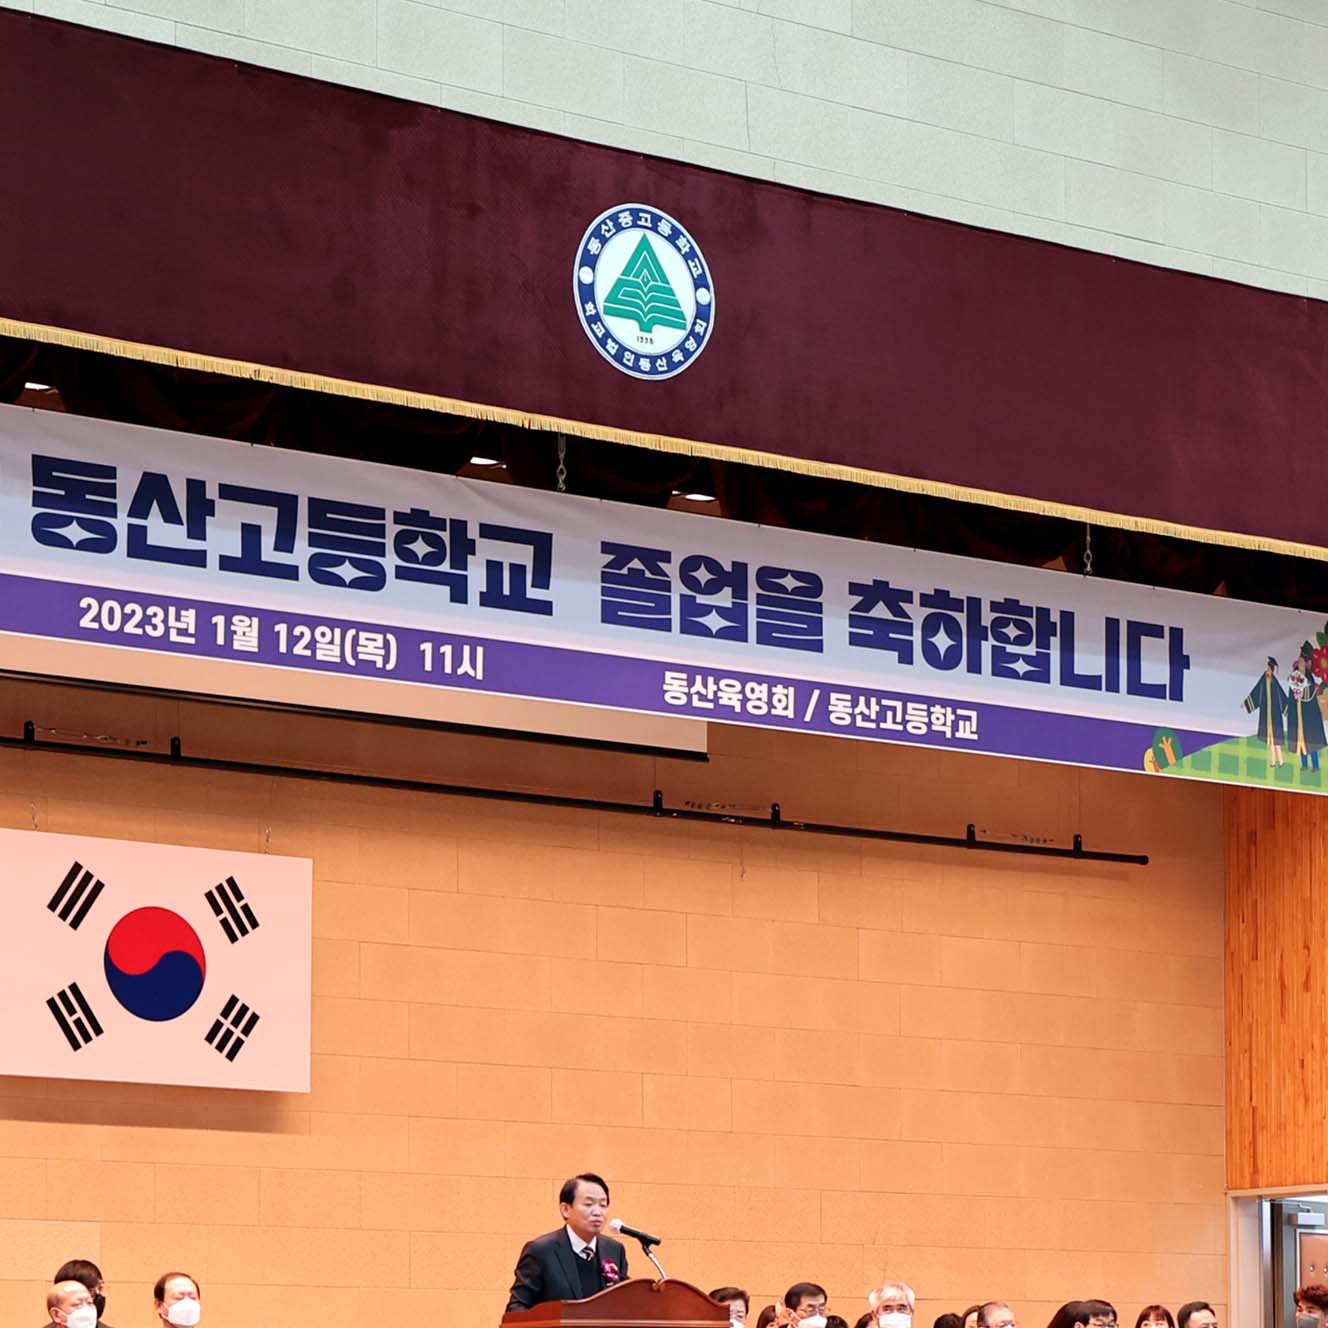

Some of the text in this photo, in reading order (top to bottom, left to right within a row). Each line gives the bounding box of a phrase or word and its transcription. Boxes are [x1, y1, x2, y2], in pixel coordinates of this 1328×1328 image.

[30, 453, 554, 618] 동산고등학교
[600, 540, 825, 654] 졸업을
[847, 579, 1191, 702] 축하합니다
[78, 596, 485, 680] 2023년 1월 12일(목) 11시
[662, 671, 980, 741] 동산육영회 / 동산고등학교
